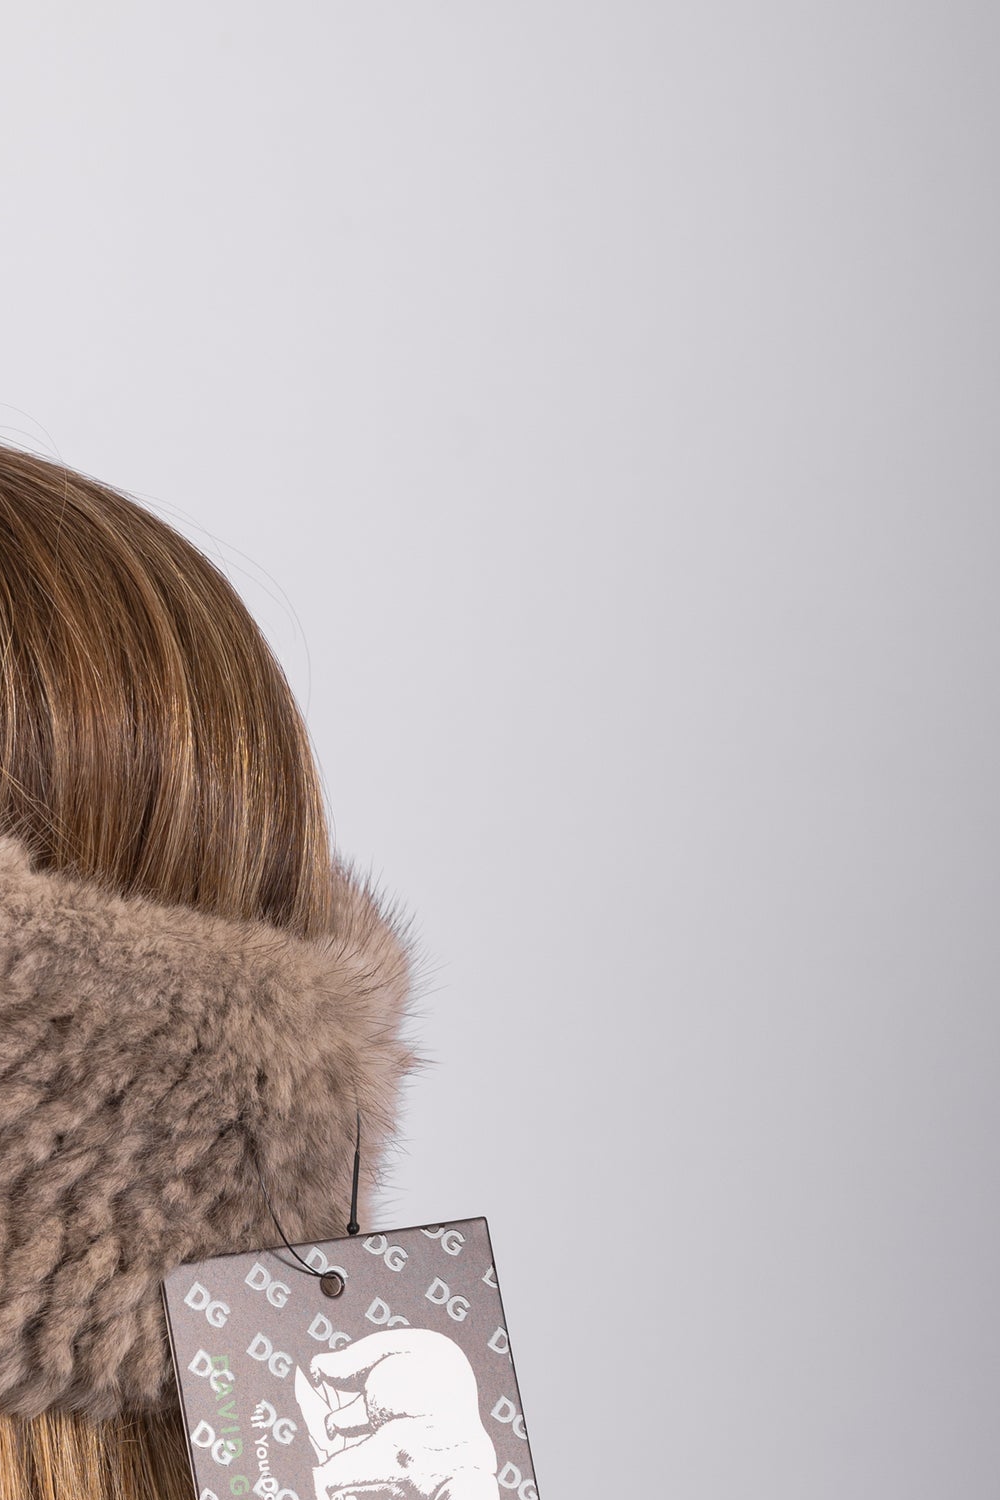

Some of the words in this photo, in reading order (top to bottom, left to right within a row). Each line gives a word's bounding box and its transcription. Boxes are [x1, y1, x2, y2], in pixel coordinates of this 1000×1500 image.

[362, 1233, 409, 1272] DG
[184, 1281, 231, 1328] DG
[244, 1262, 292, 1308] DG
[425, 1277, 471, 1322] DG
[188, 1349, 235, 1396] DG
[246, 1332, 293, 1379] DG
[211, 1355, 244, 1457] DAVID
[254, 1399, 298, 1445] DG
[190, 1419, 236, 1467] DG
[255, 1435, 270, 1473] You
